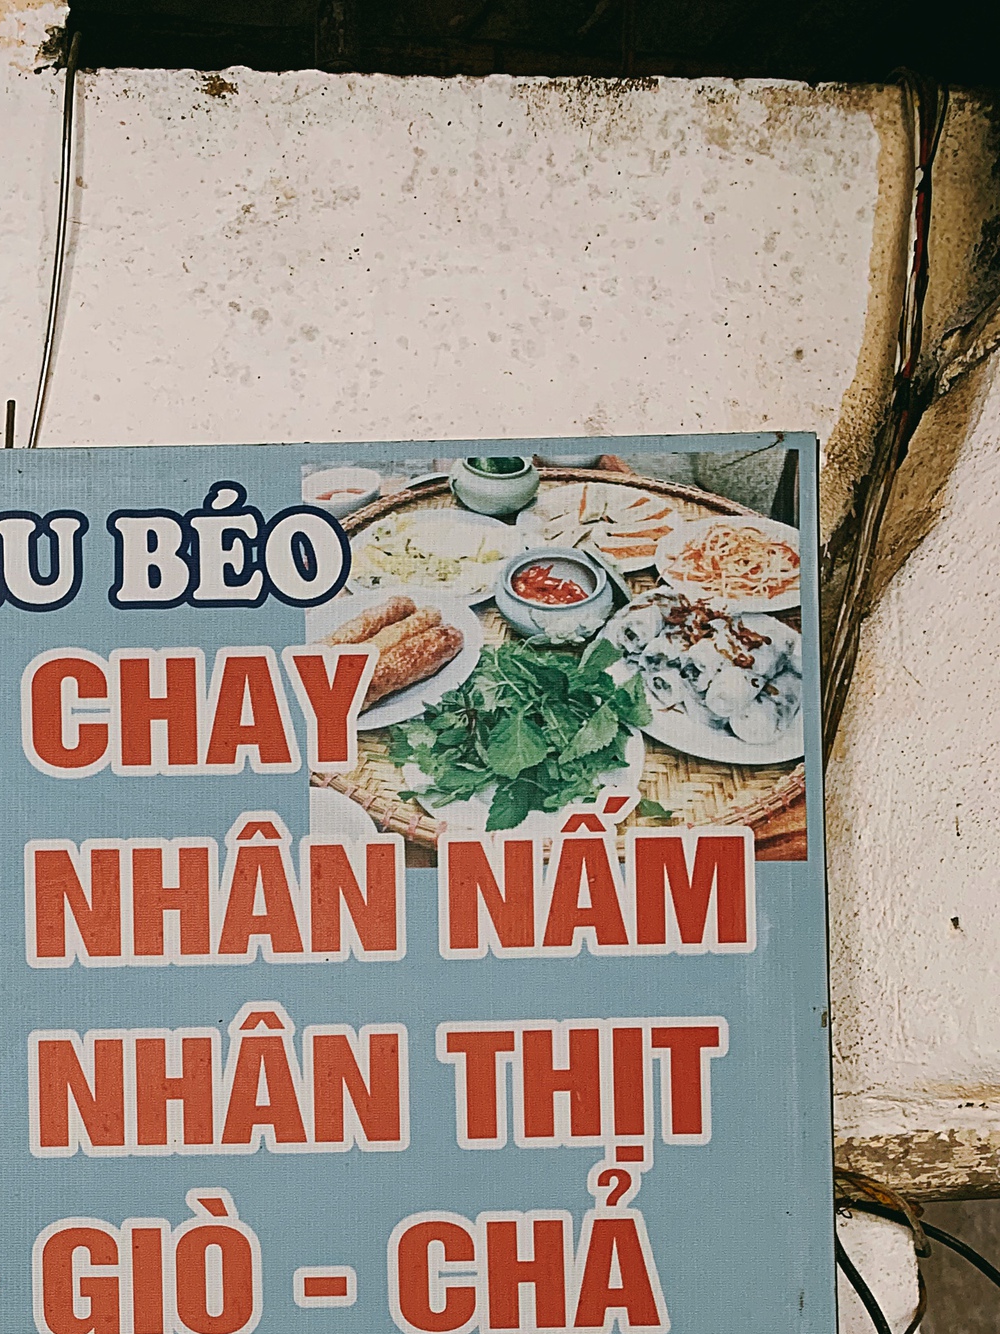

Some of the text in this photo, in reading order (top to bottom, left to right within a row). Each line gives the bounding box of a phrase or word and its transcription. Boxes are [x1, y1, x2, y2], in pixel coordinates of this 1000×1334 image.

[108, 480, 353, 612] BÉO
[23, 646, 376, 776] CHAY
[26, 790, 757, 969] NHÂN NẤM
[29, 1002, 729, 1172] NHÂN THỊT
